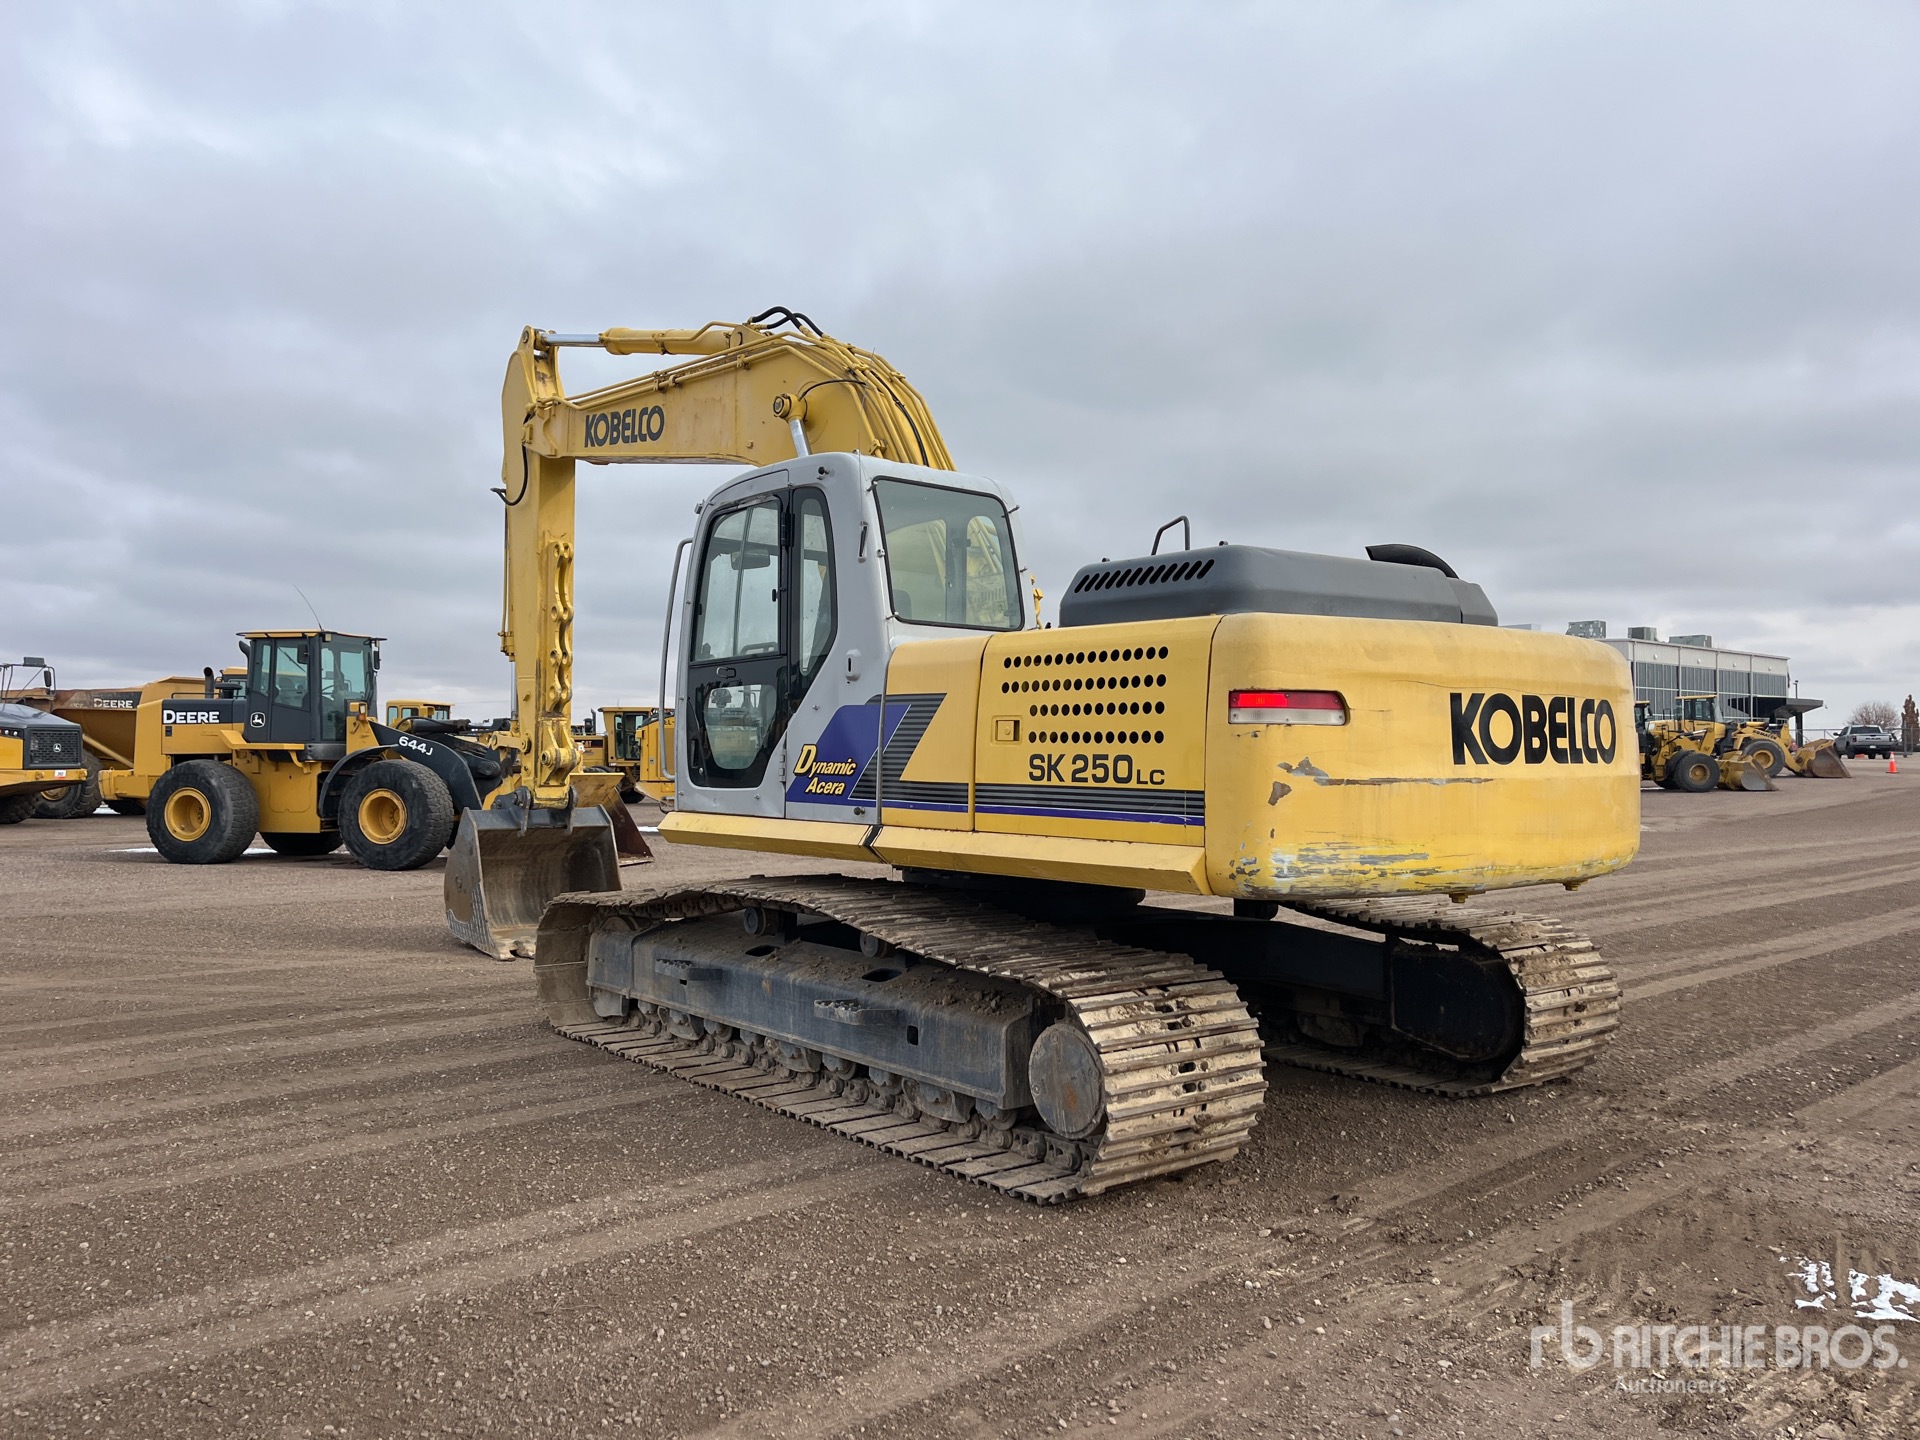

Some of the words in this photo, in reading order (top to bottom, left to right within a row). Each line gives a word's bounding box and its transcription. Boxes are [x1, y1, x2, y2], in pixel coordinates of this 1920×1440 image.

[584, 405, 665, 448] KOBELCO
[163, 709, 220, 724] DEERE
[1449, 692, 1617, 766] KOBELCO
[398, 736, 434, 756] 644J
[793, 744, 858, 779] Dynamic
[804, 776, 847, 796] Acera
